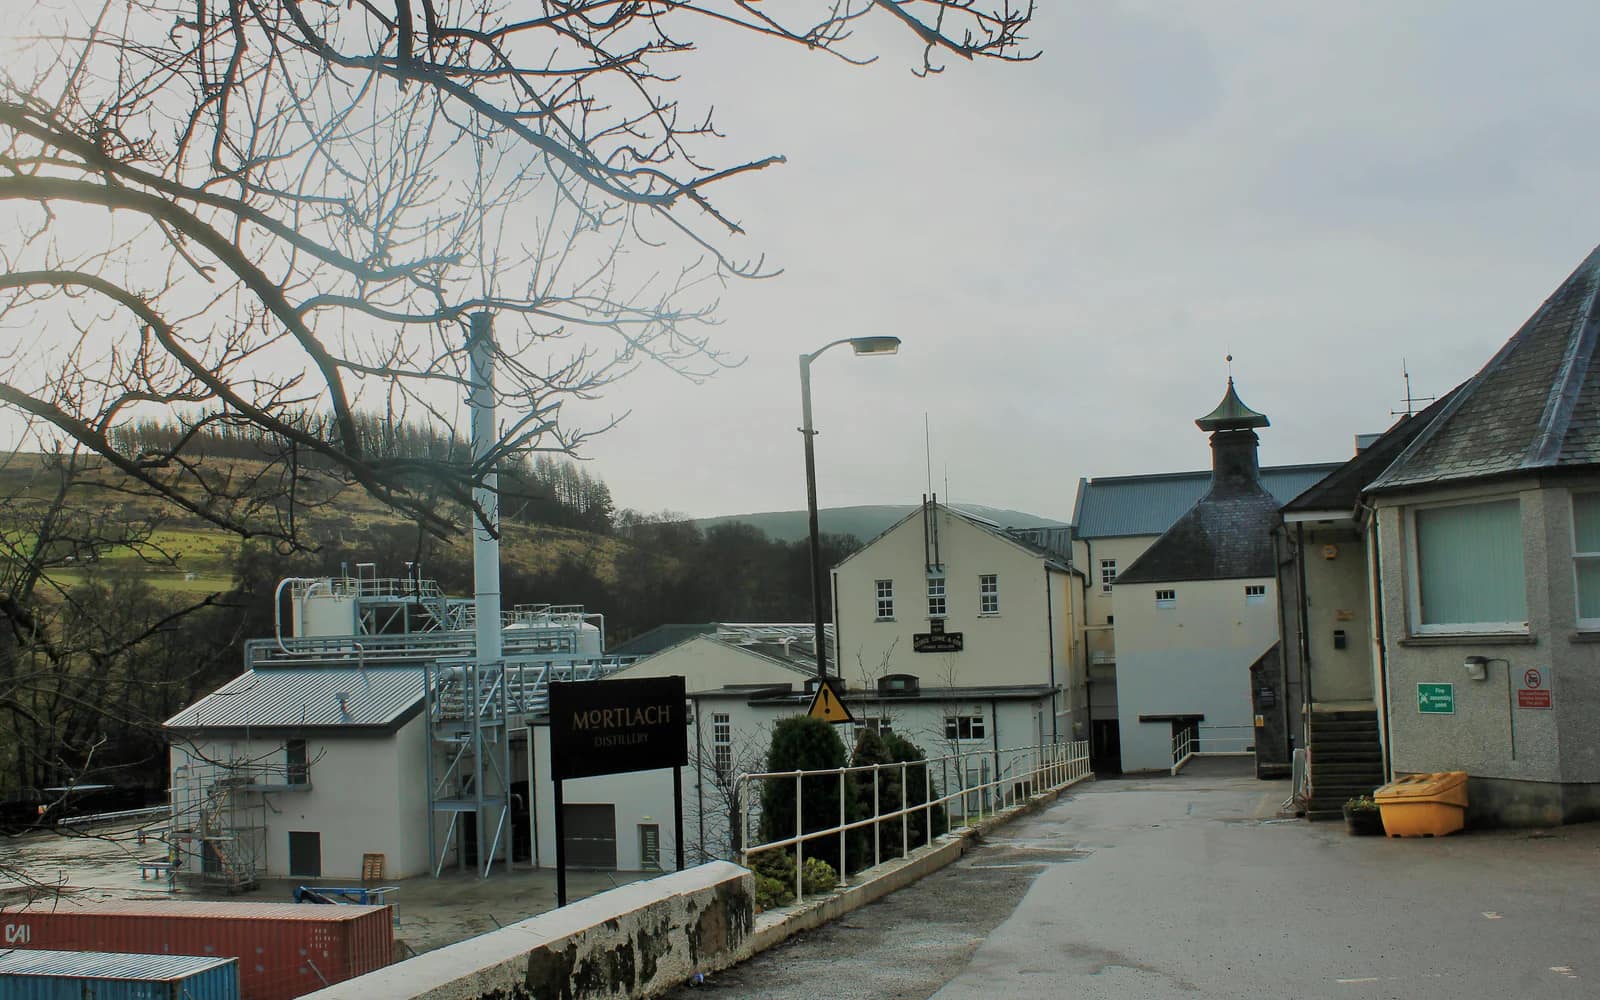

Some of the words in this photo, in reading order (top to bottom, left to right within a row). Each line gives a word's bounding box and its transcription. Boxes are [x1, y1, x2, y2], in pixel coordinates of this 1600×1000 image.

[572, 704, 671, 730] MORTLACH
[594, 733, 649, 747] DISTILLERY
[5, 923, 31, 943] CAI
